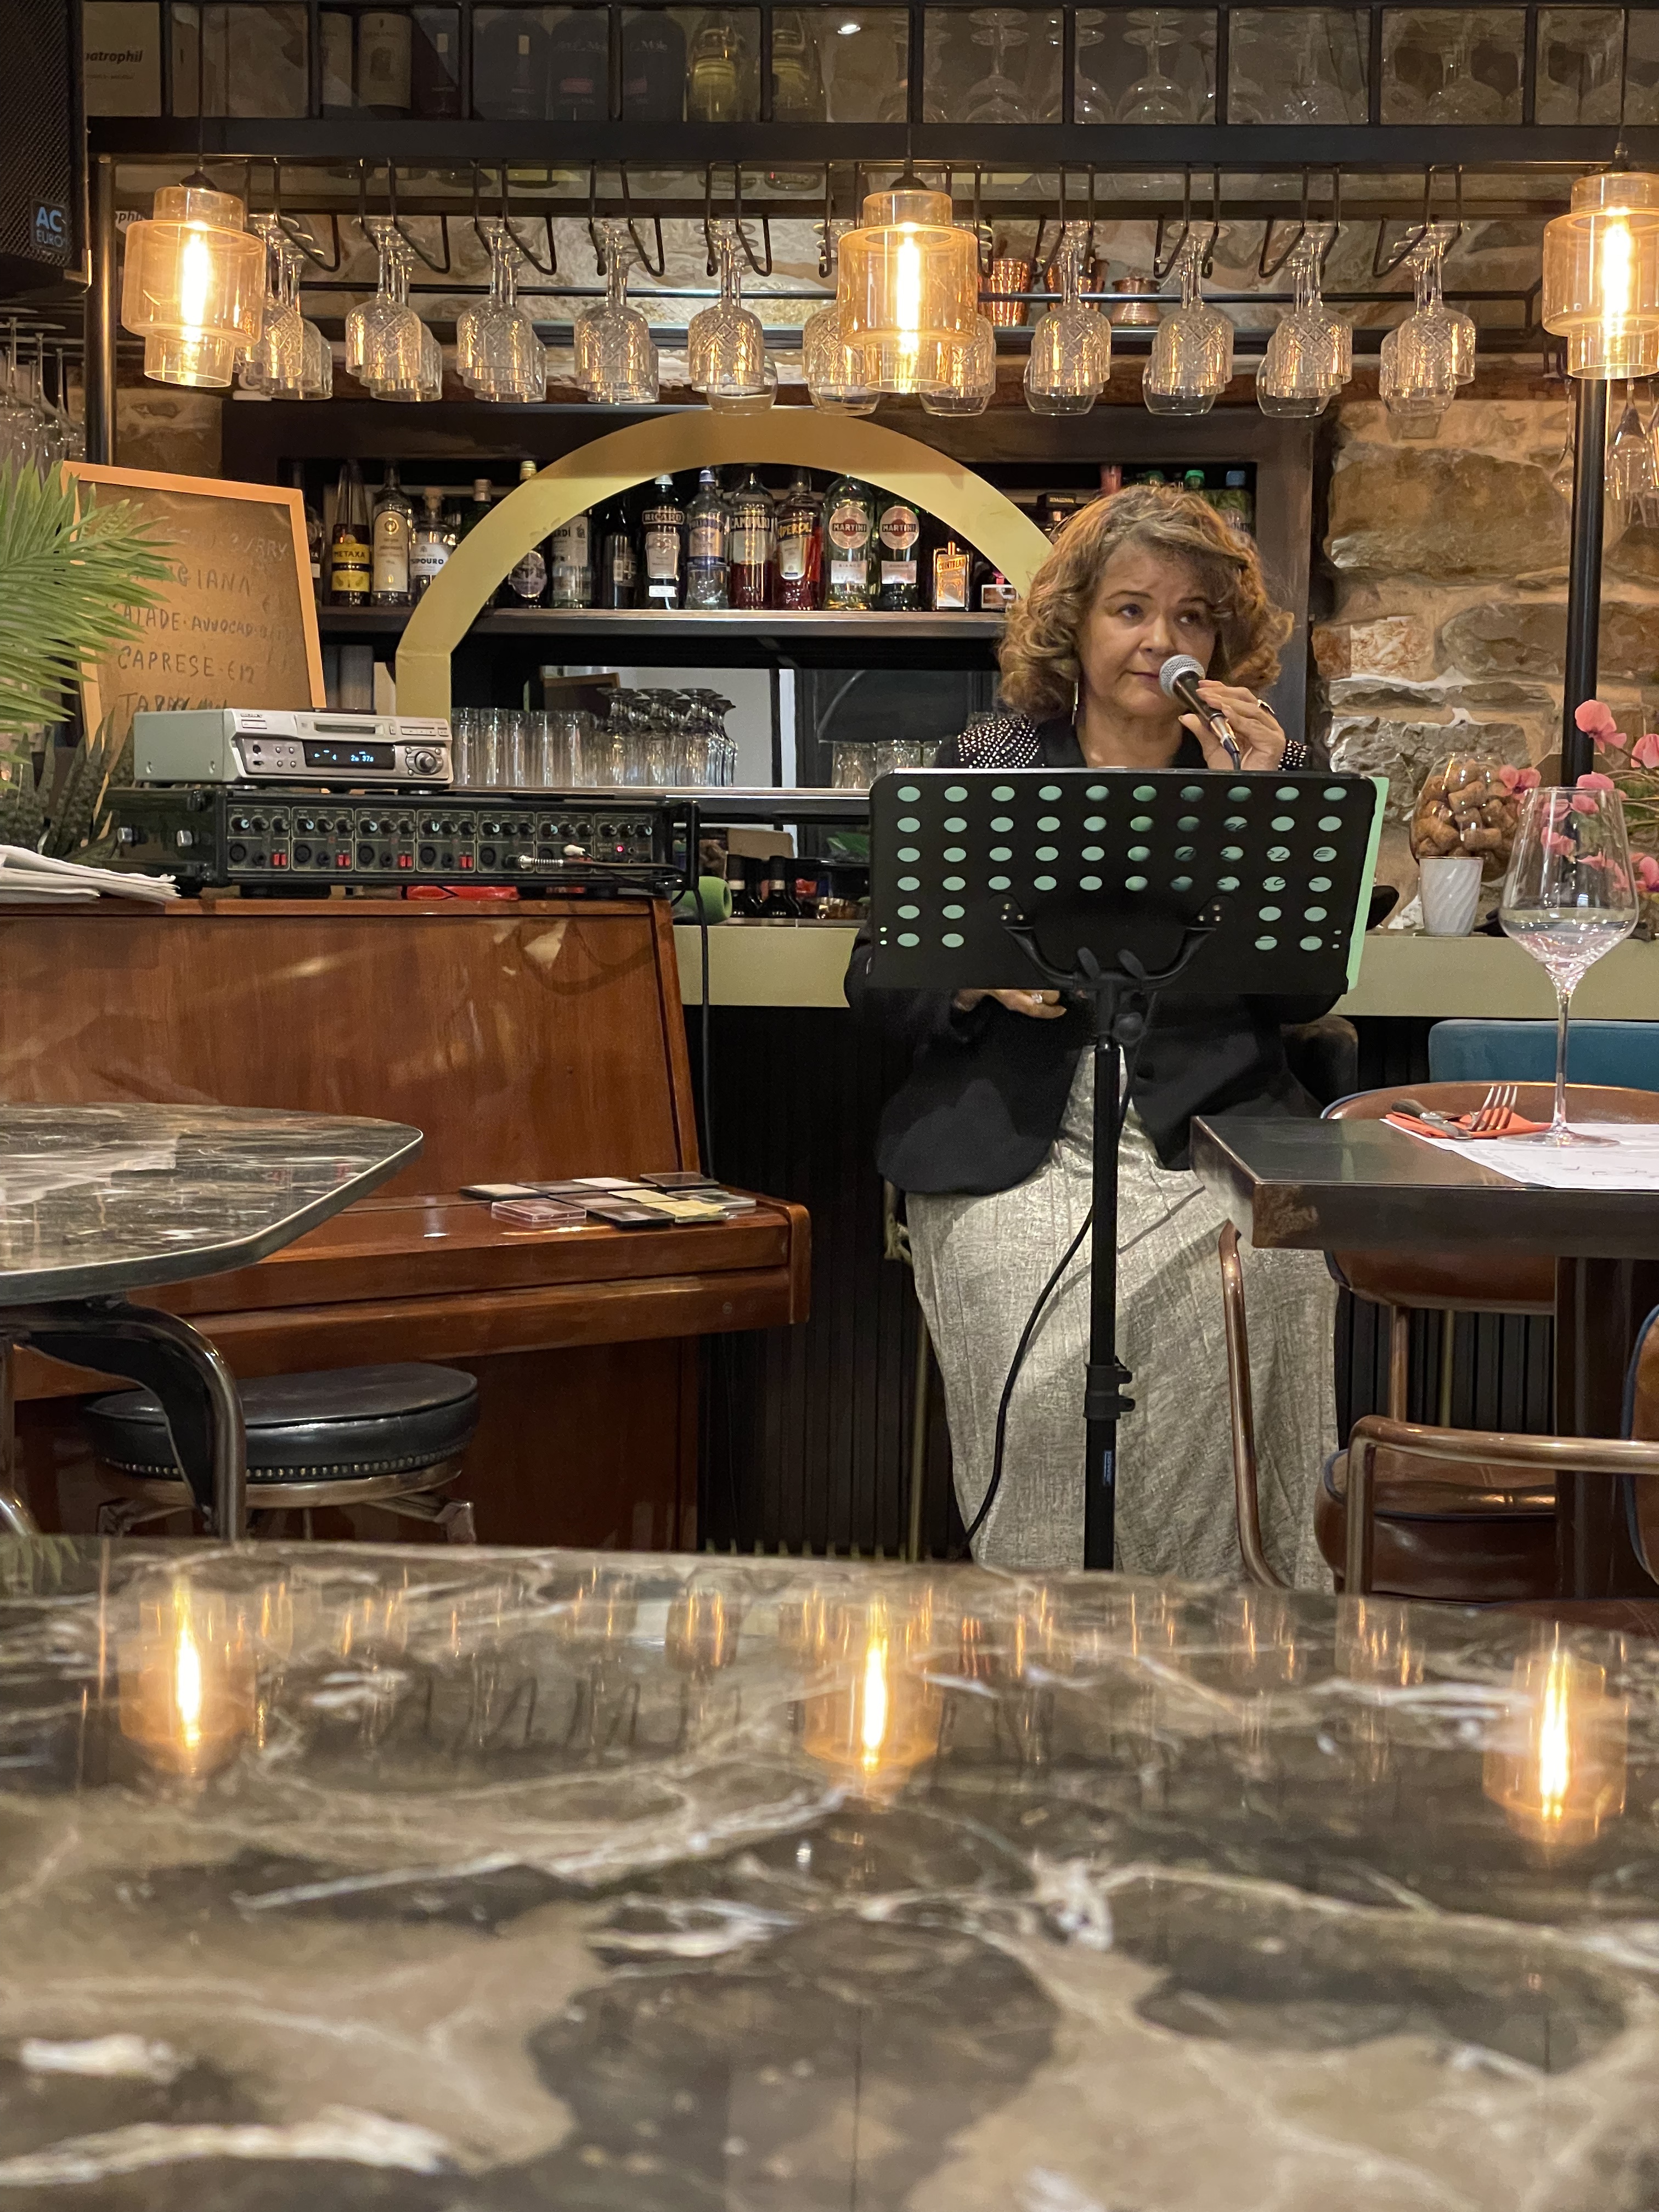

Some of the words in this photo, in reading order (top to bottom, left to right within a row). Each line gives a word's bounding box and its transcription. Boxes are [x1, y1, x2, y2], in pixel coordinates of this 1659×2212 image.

[36, 206, 63, 233] AC
[36, 229, 64, 247] EURO
[833, 523, 866, 532] MARTINI
[113, 603, 180, 631] ALADE
[117, 646, 215, 678] CAPRESE
